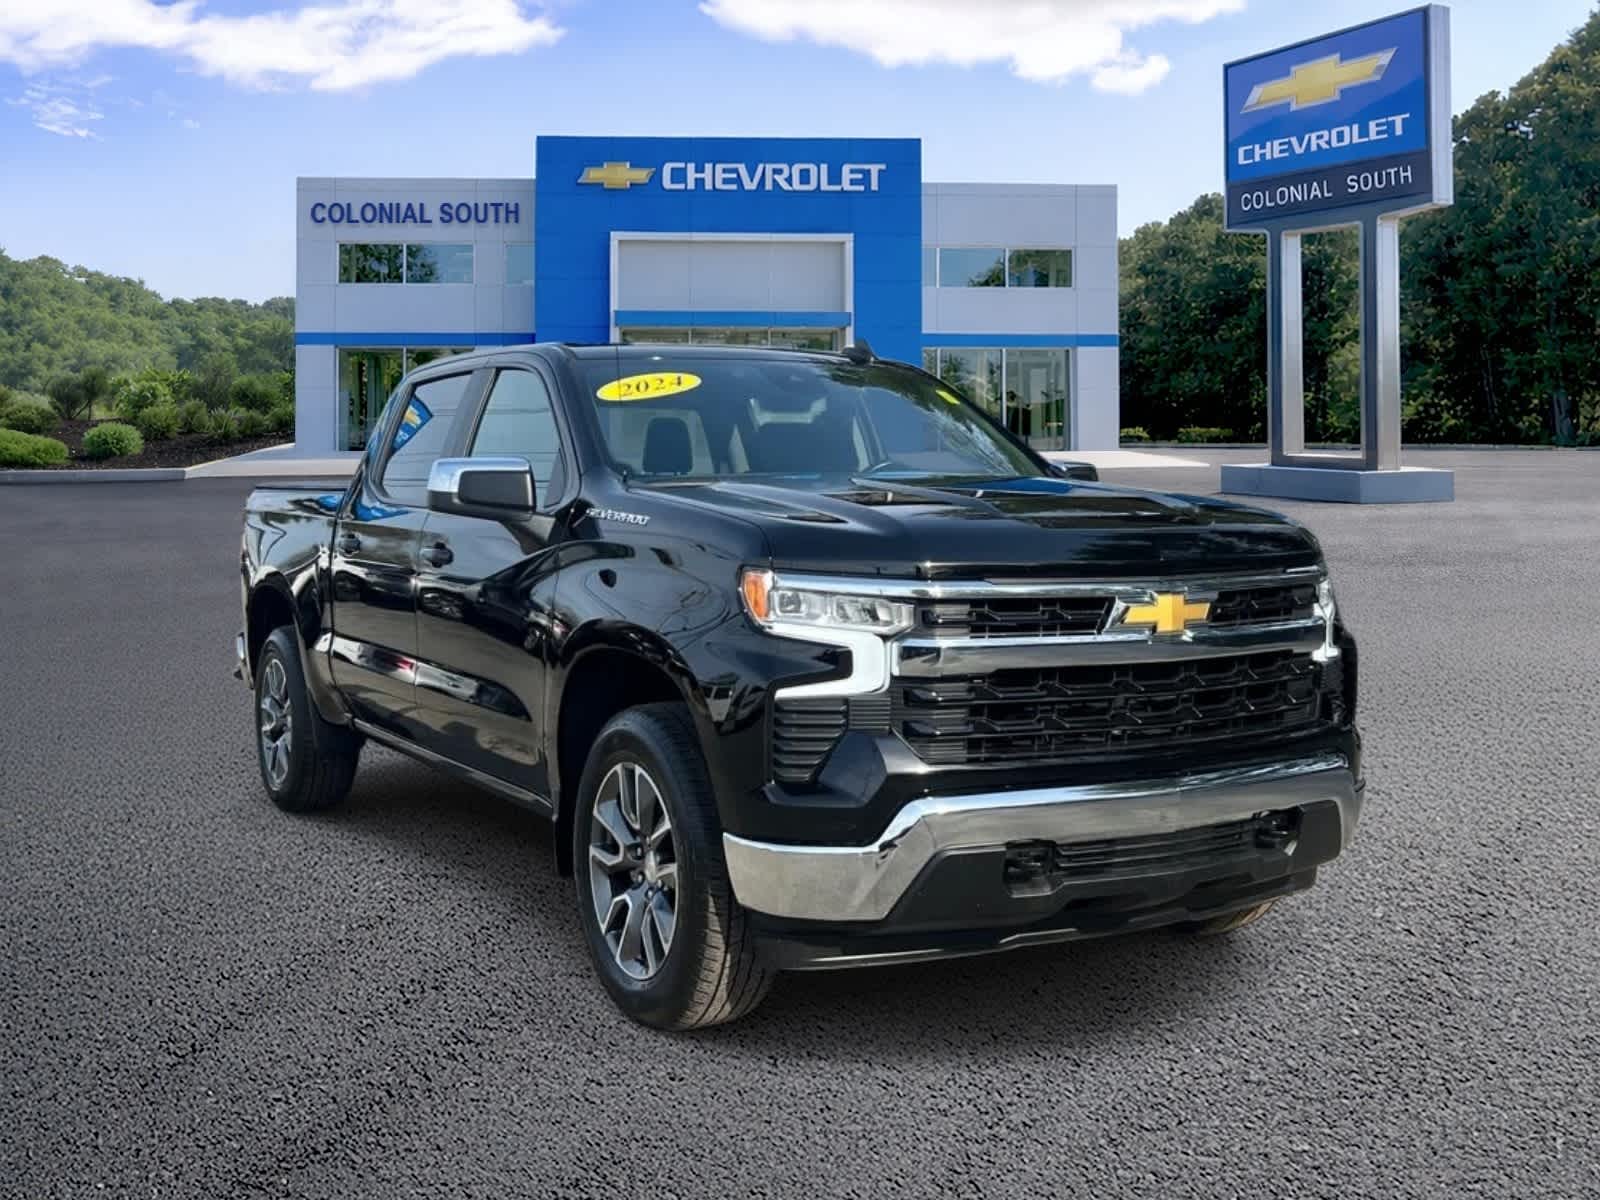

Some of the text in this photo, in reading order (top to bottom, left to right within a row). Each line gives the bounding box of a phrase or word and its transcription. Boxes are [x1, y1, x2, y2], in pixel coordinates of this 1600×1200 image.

[1237, 113, 1410, 165] CHEVROLET
[662, 161, 887, 192] CHEVROLET
[1240, 165, 1413, 212] COLONIAL SOUTH
[310, 202, 520, 224] COLONIAL SOUTH
[622, 375, 682, 397] 2024
